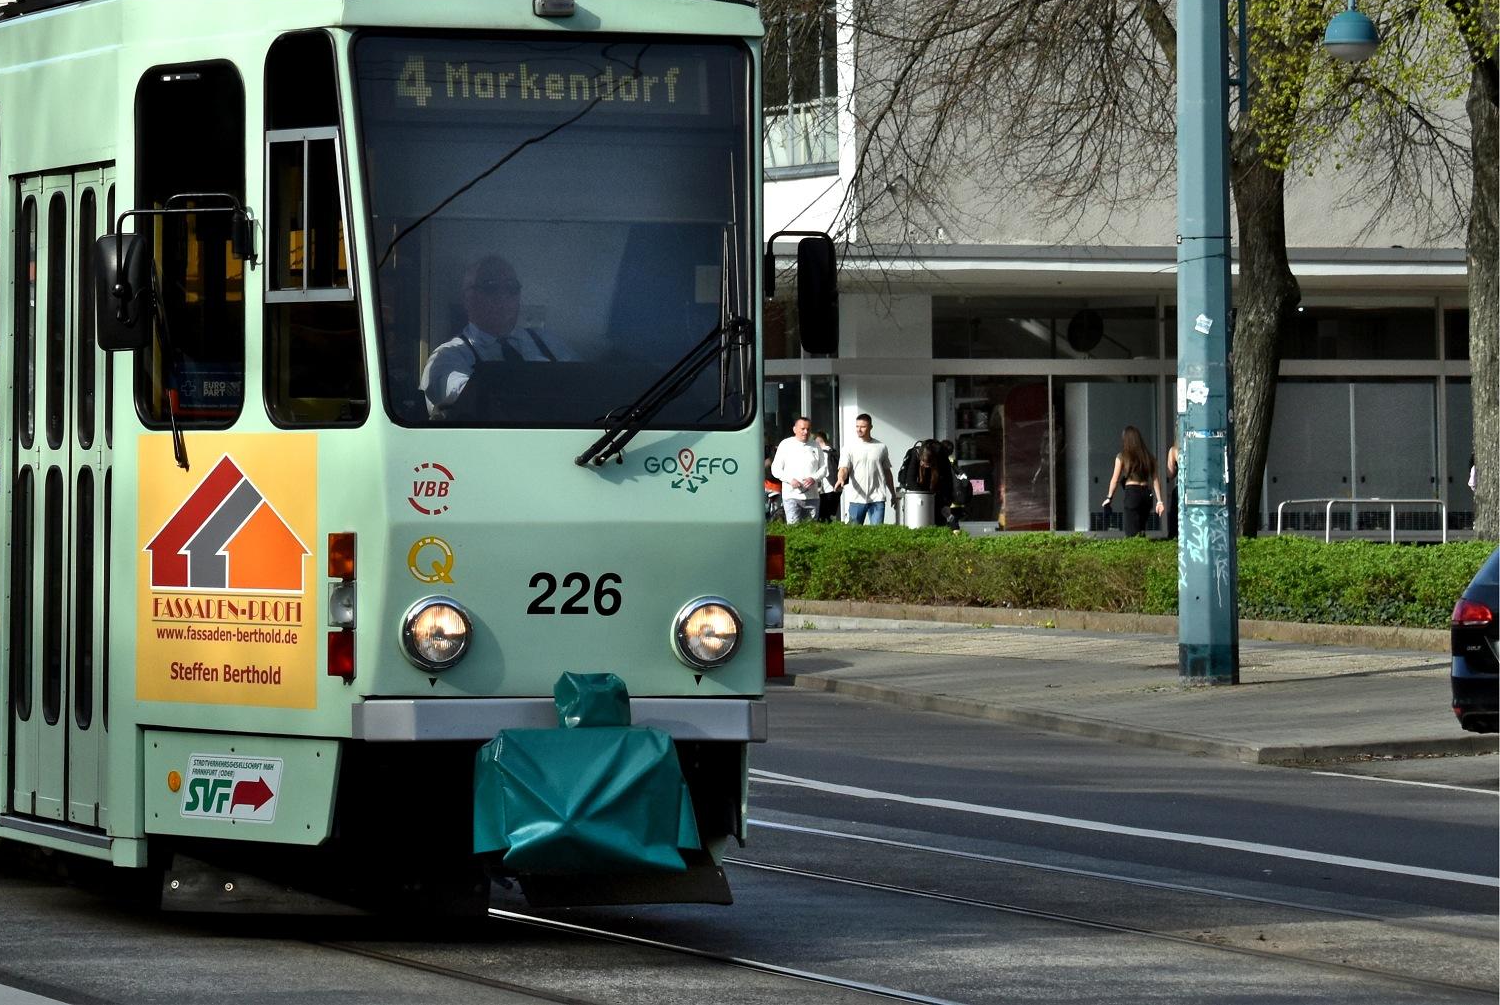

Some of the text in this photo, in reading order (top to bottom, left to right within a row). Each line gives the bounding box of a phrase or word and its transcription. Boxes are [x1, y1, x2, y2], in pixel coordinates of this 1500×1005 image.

[395, 54, 680, 107] 4 Markendorf
[203, 381, 226, 389] EURO
[203, 389, 226, 397] PART
[412, 480, 450, 497] VBB
[526, 571, 623, 616] 226
[152, 597, 302, 623] FASSADEN-PROFI
[156, 625, 298, 645] www.fassaden-berthold.de
[170, 661, 281, 685] Steffen Berthold
[191, 768, 235, 778] FRANKFURT (ODER)
[192, 759, 275, 771] STADTVERKEHRSGESELLSCHAFT MBH
[184, 777, 233, 814] SVF
